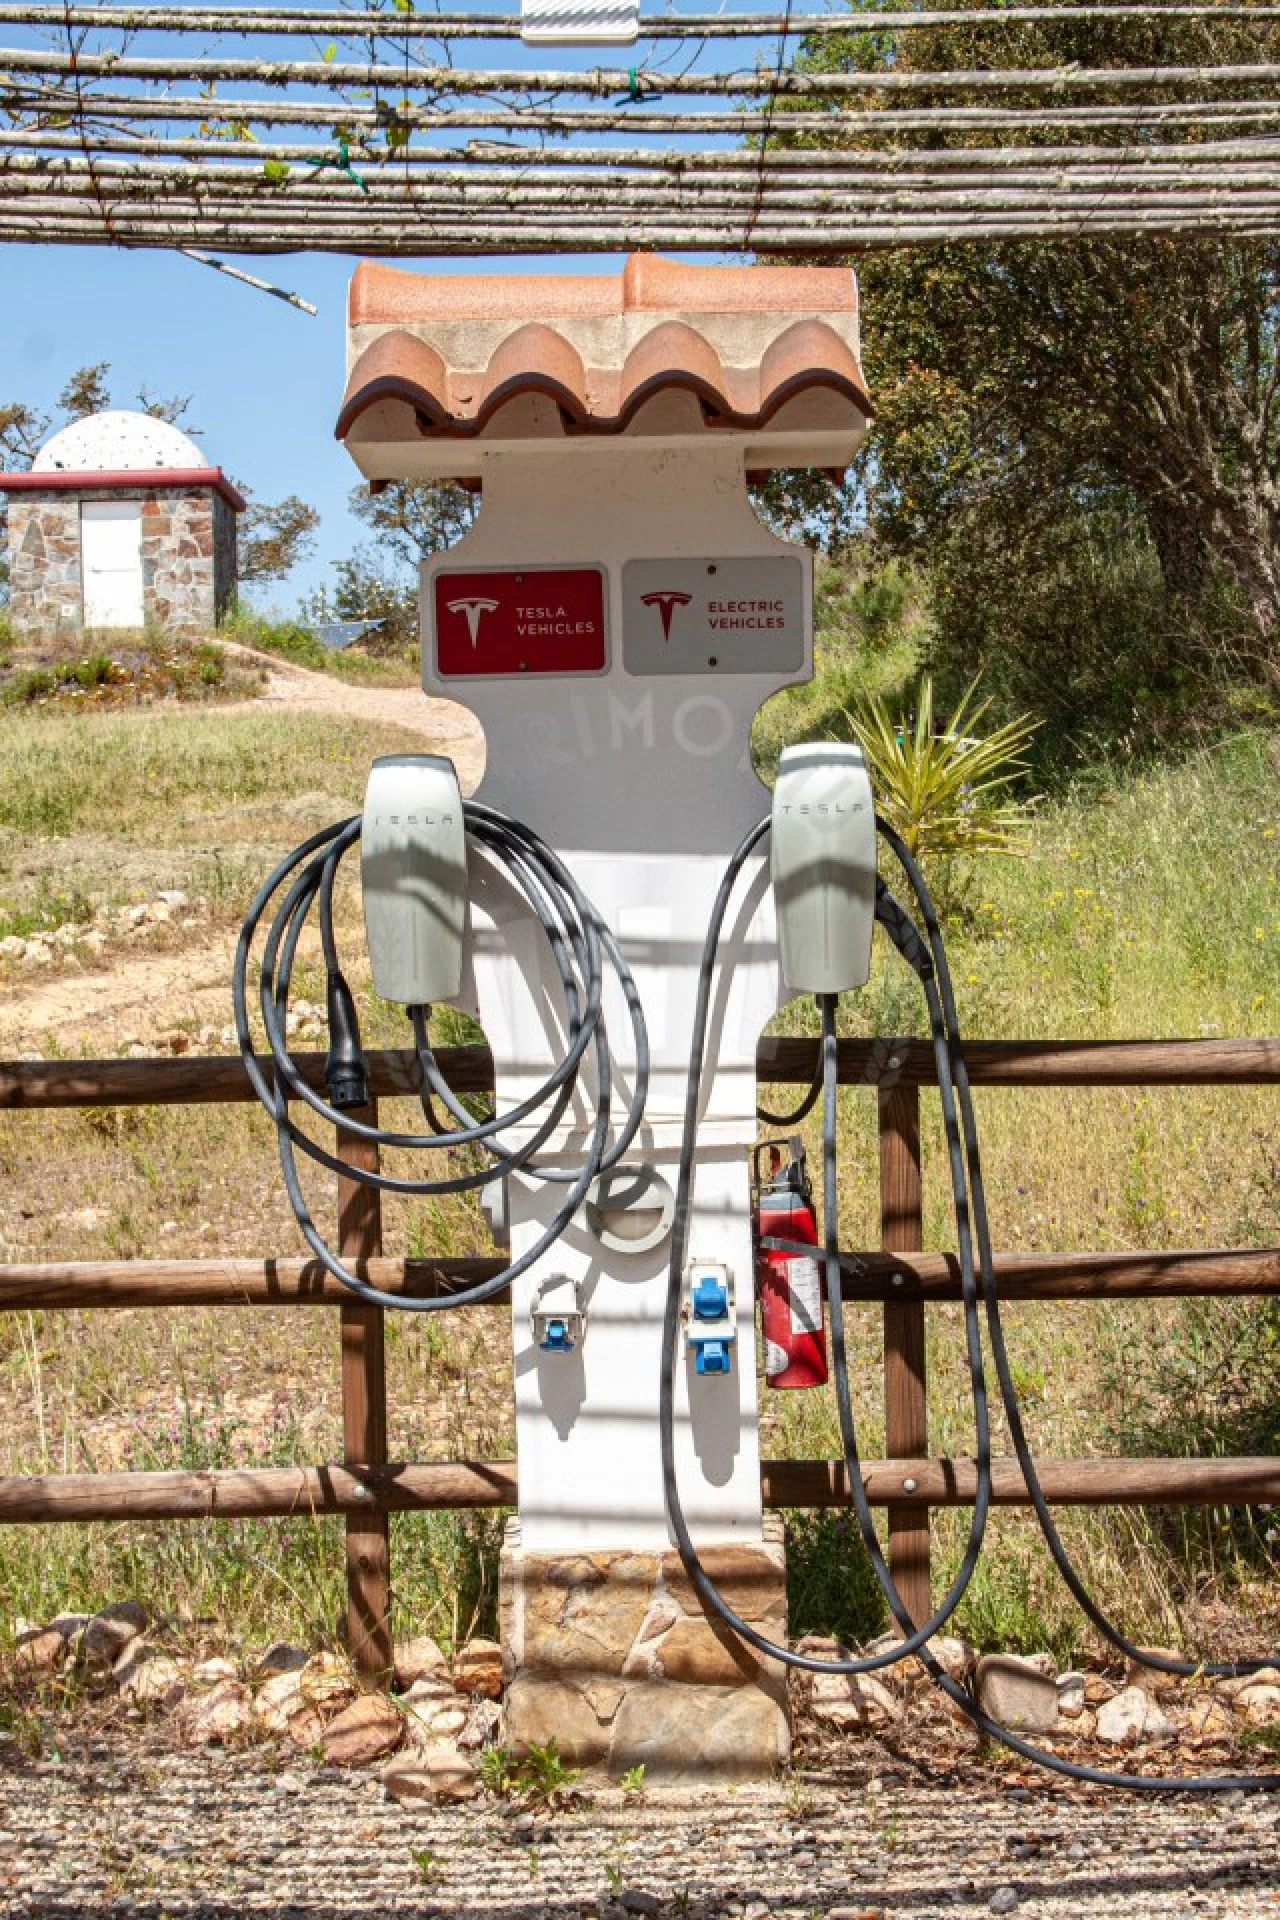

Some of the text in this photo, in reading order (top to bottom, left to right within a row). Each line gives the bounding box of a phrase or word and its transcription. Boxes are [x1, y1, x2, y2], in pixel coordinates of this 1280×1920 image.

[516, 606, 566, 619] TESLA
[708, 600, 785, 613] ELECTRIC
[517, 621, 595, 636] VEHICLES
[708, 617, 785, 630] VEHICLES
[782, 803, 865, 815] TESLA
